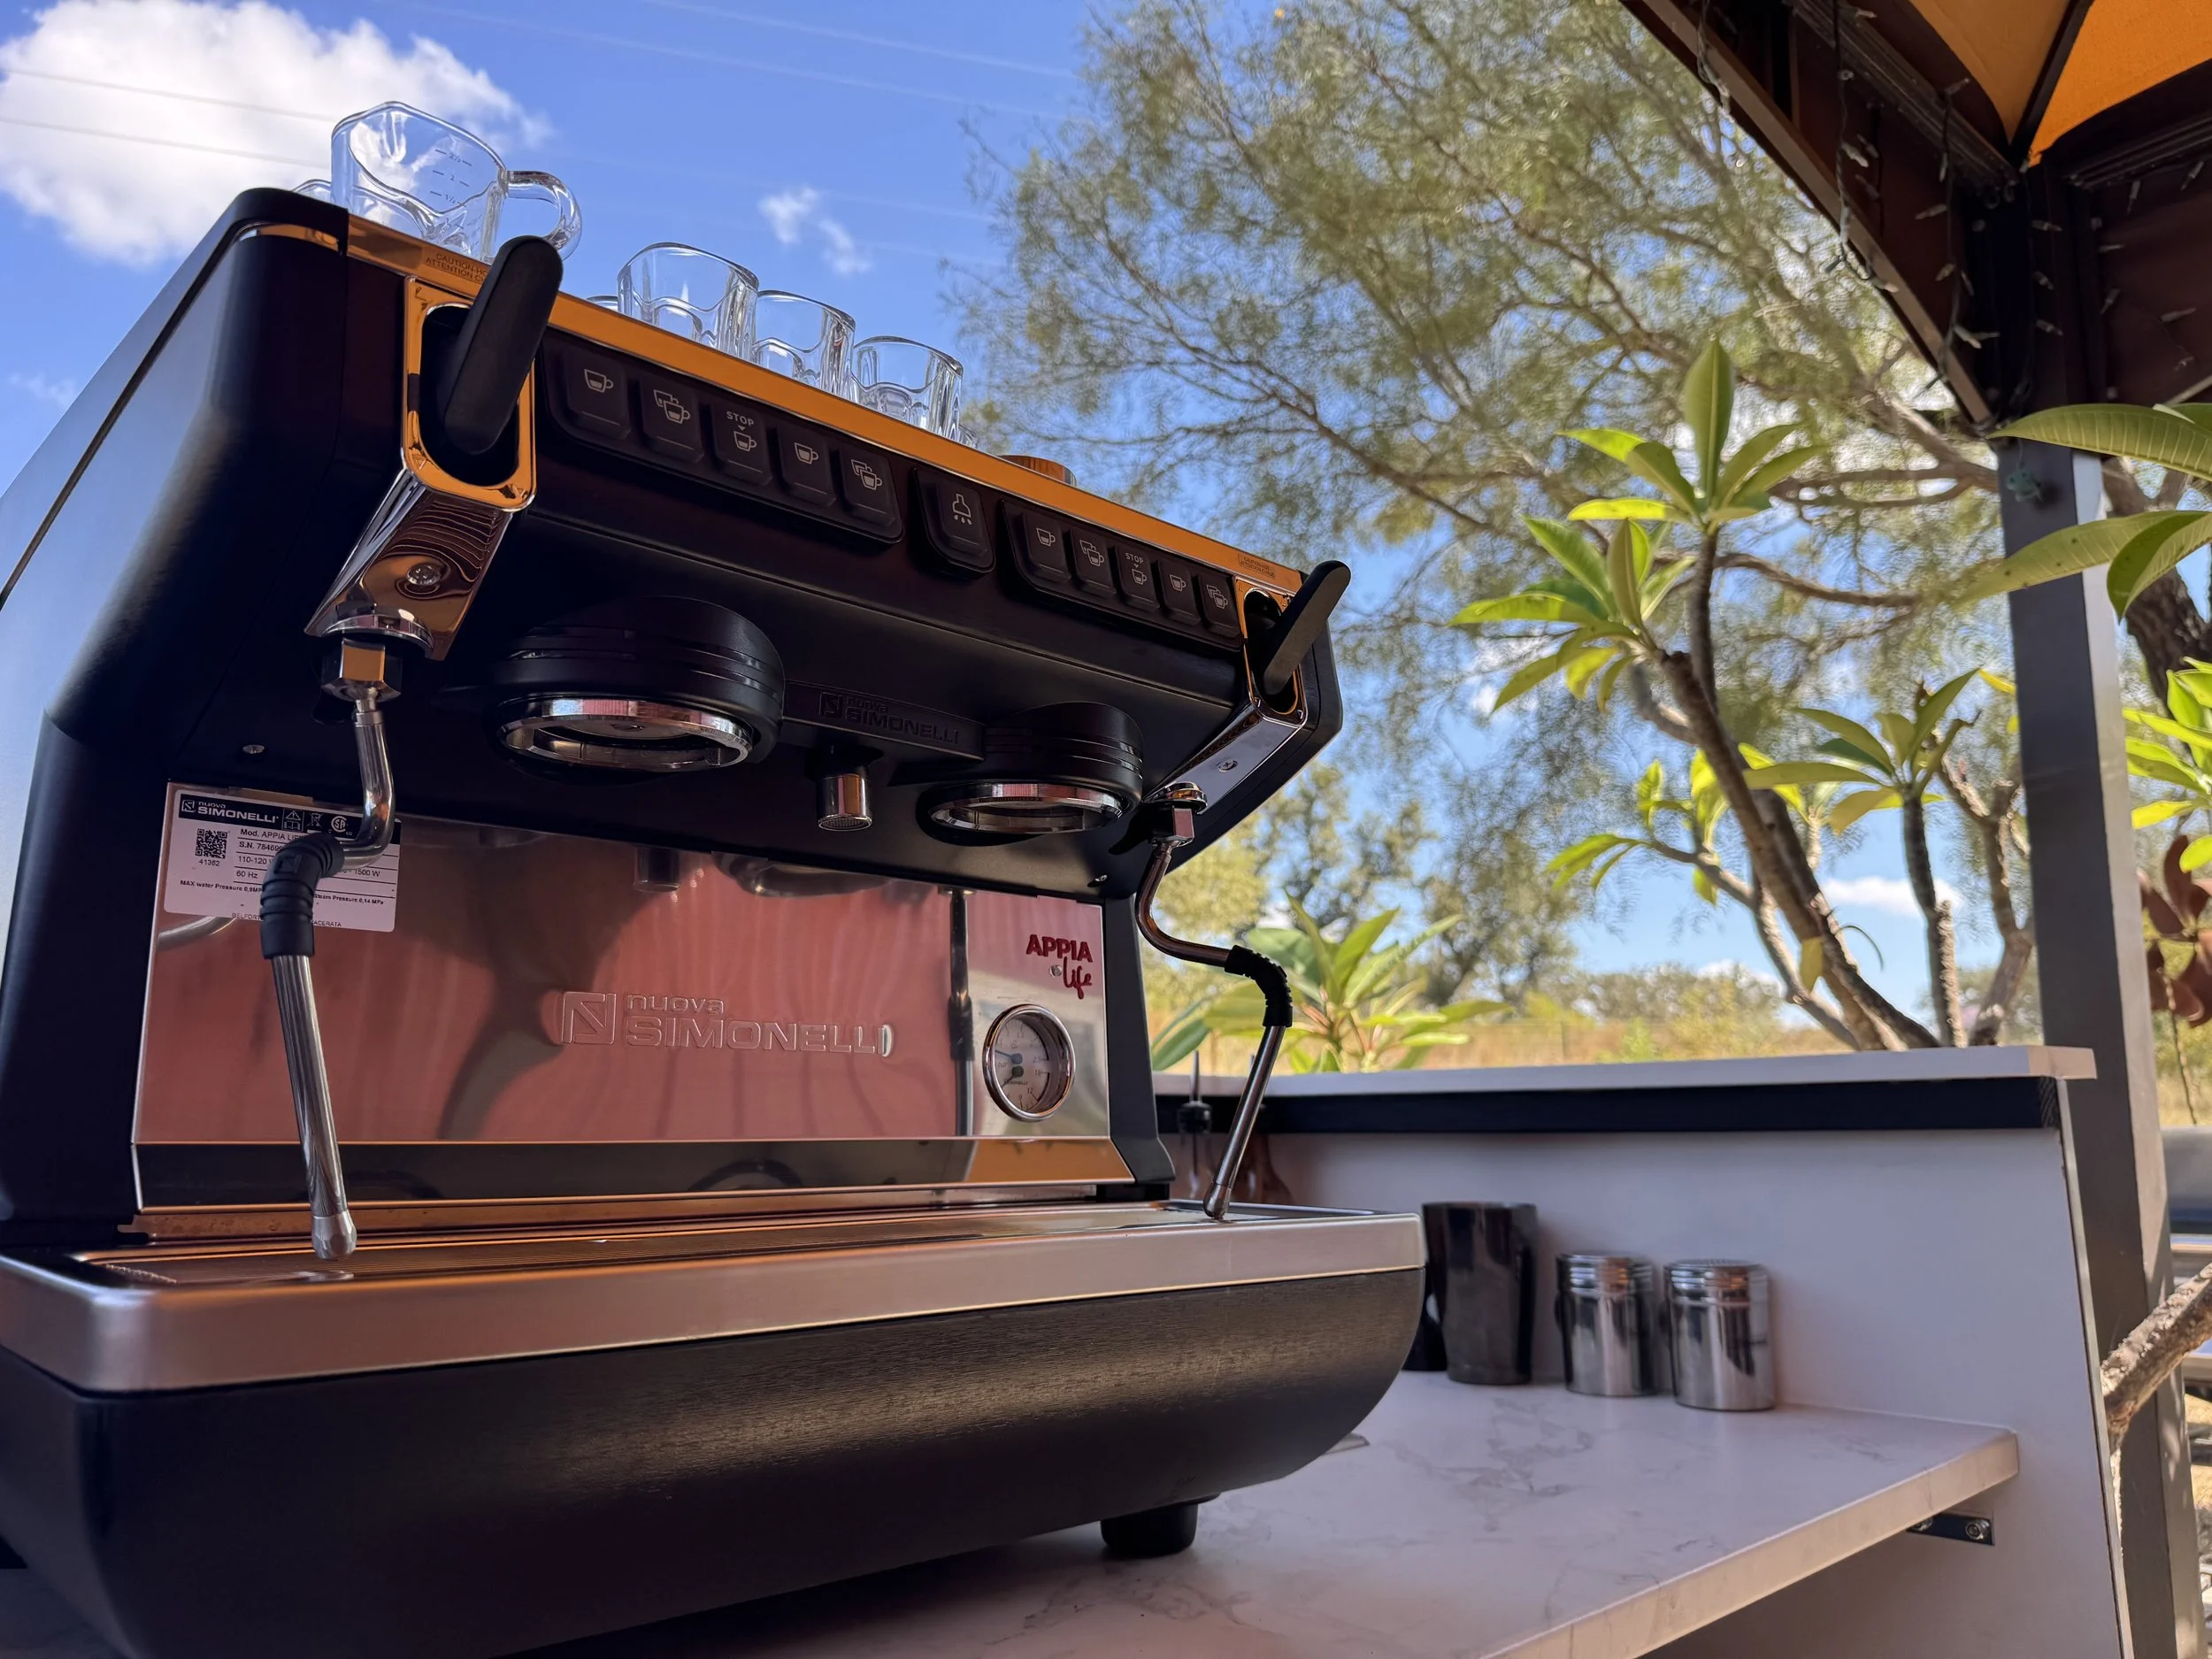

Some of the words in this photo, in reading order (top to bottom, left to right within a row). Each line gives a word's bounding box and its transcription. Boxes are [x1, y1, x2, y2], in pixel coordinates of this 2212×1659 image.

[426, 257, 472, 279] ATTENTION
[726, 411, 755, 427] STOP
[1125, 552, 1144, 565] STOP
[847, 696, 888, 713] nuova
[845, 706, 959, 744] SIMONELLI
[197, 806, 276, 824] SIMONELLI
[240, 828, 259, 837] Mod.
[261, 831, 286, 840] APPIA
[238, 856, 267, 864] 110-120
[215, 883, 242, 892] Pressure
[1025, 933, 1094, 963] APPIA
[626, 993, 725, 1015] nuova
[625, 1016, 887, 1056] SIMONELLI
